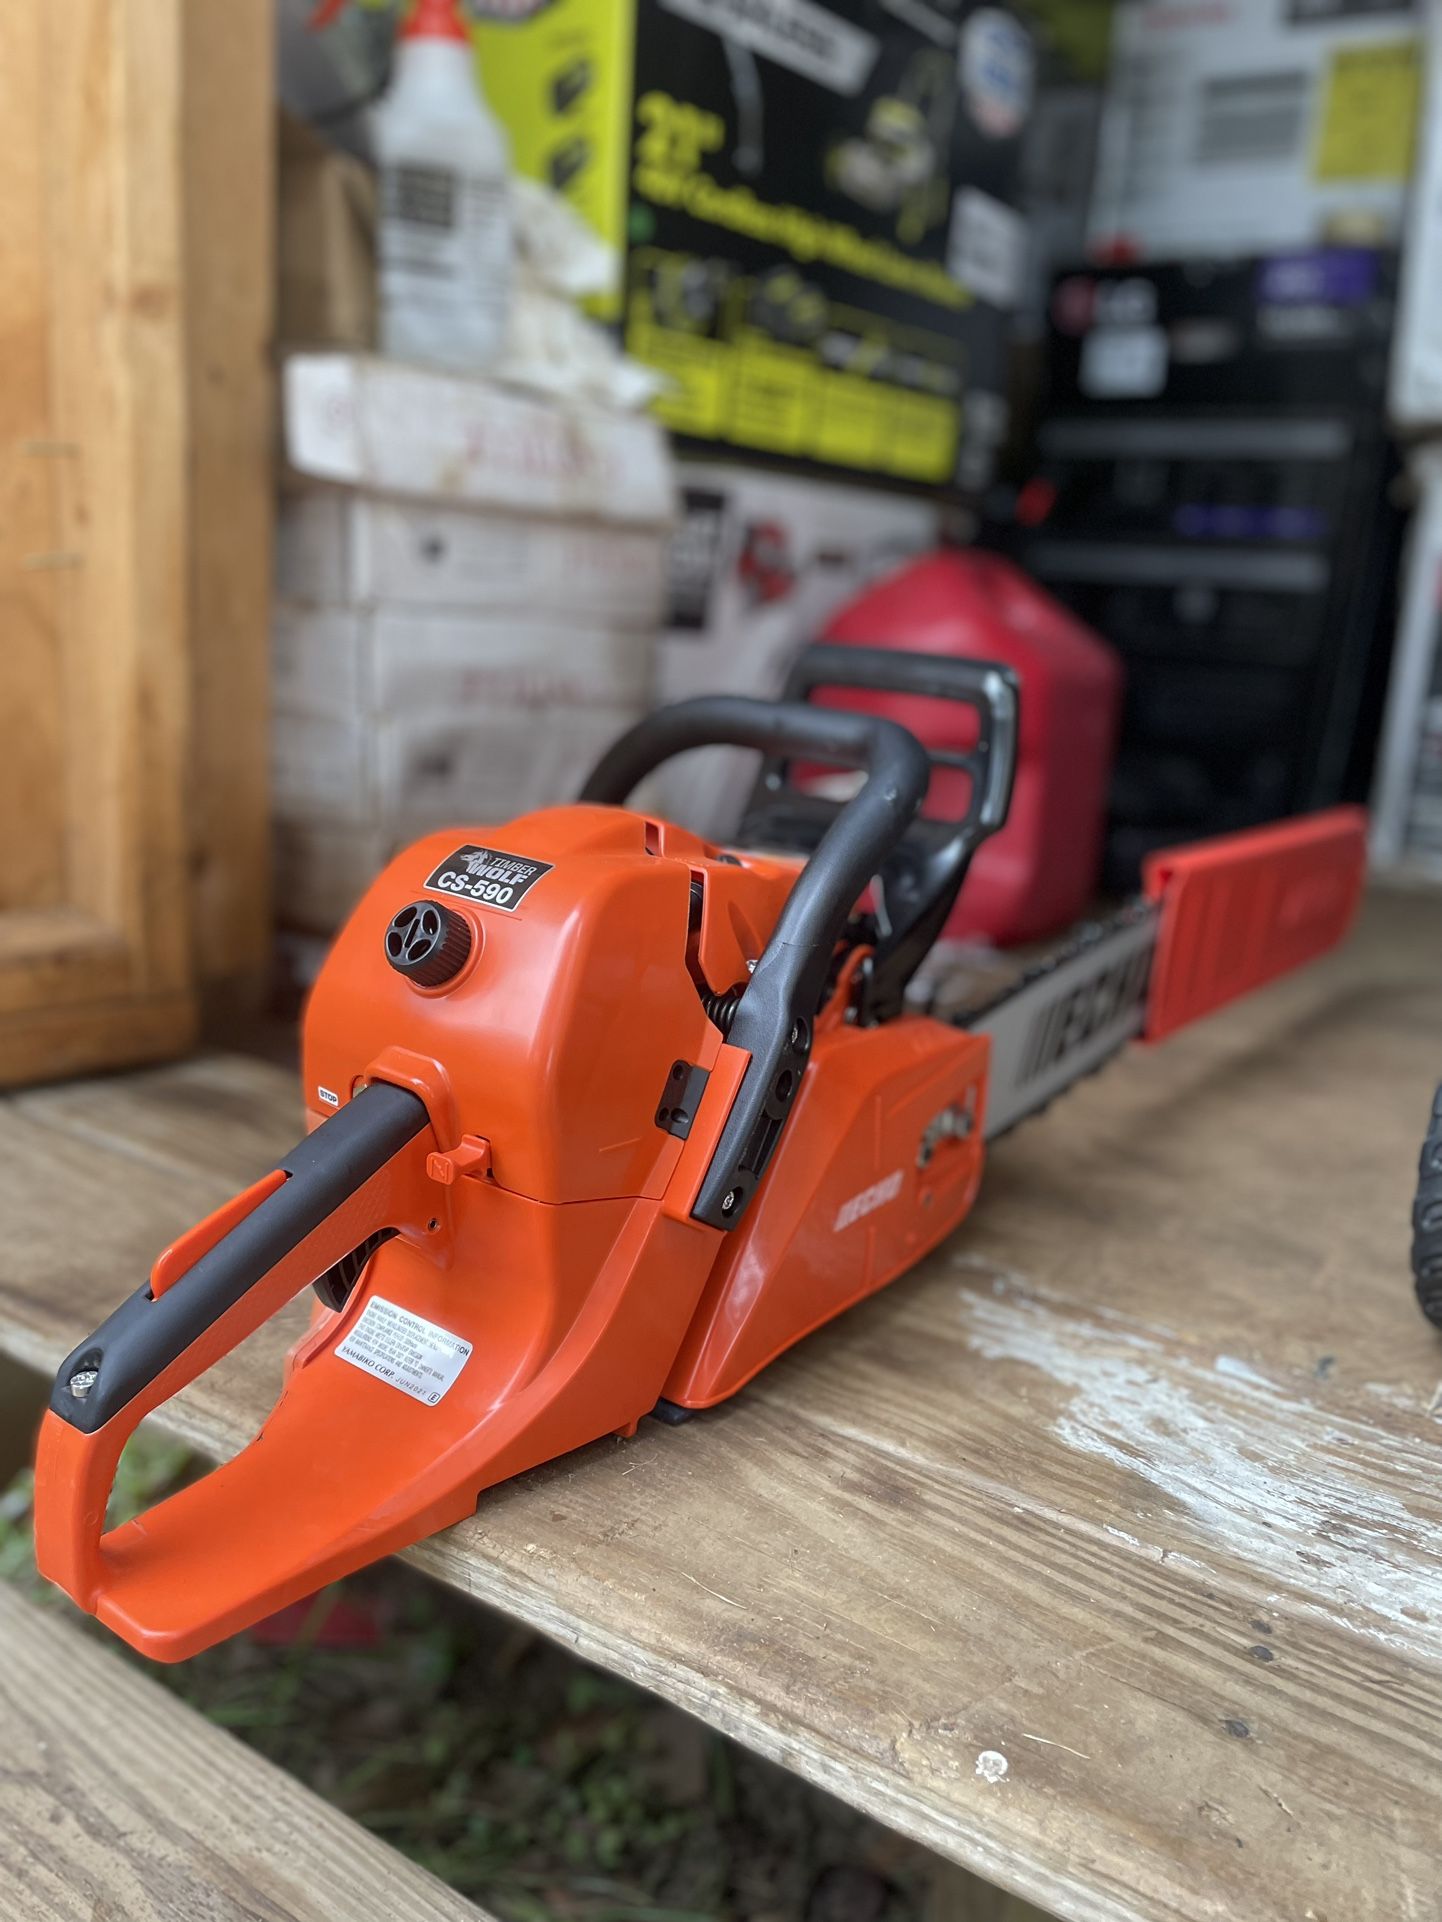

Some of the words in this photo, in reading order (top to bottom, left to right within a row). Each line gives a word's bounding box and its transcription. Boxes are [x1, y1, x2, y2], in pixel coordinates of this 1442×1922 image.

[467, 863, 528, 885] WOLF
[491, 857, 537, 876] TIMBER
[437, 871, 513, 904] CS-590
[320, 1089, 337, 1102] STOP
[371, 1301, 397, 1319] EMISSION
[399, 1316, 426, 1334] CONTROL
[428, 1331, 469, 1356] INFORMATION
[342, 1346, 375, 1367] YAMABIKO
[374, 1364, 395, 1379] CORP.
